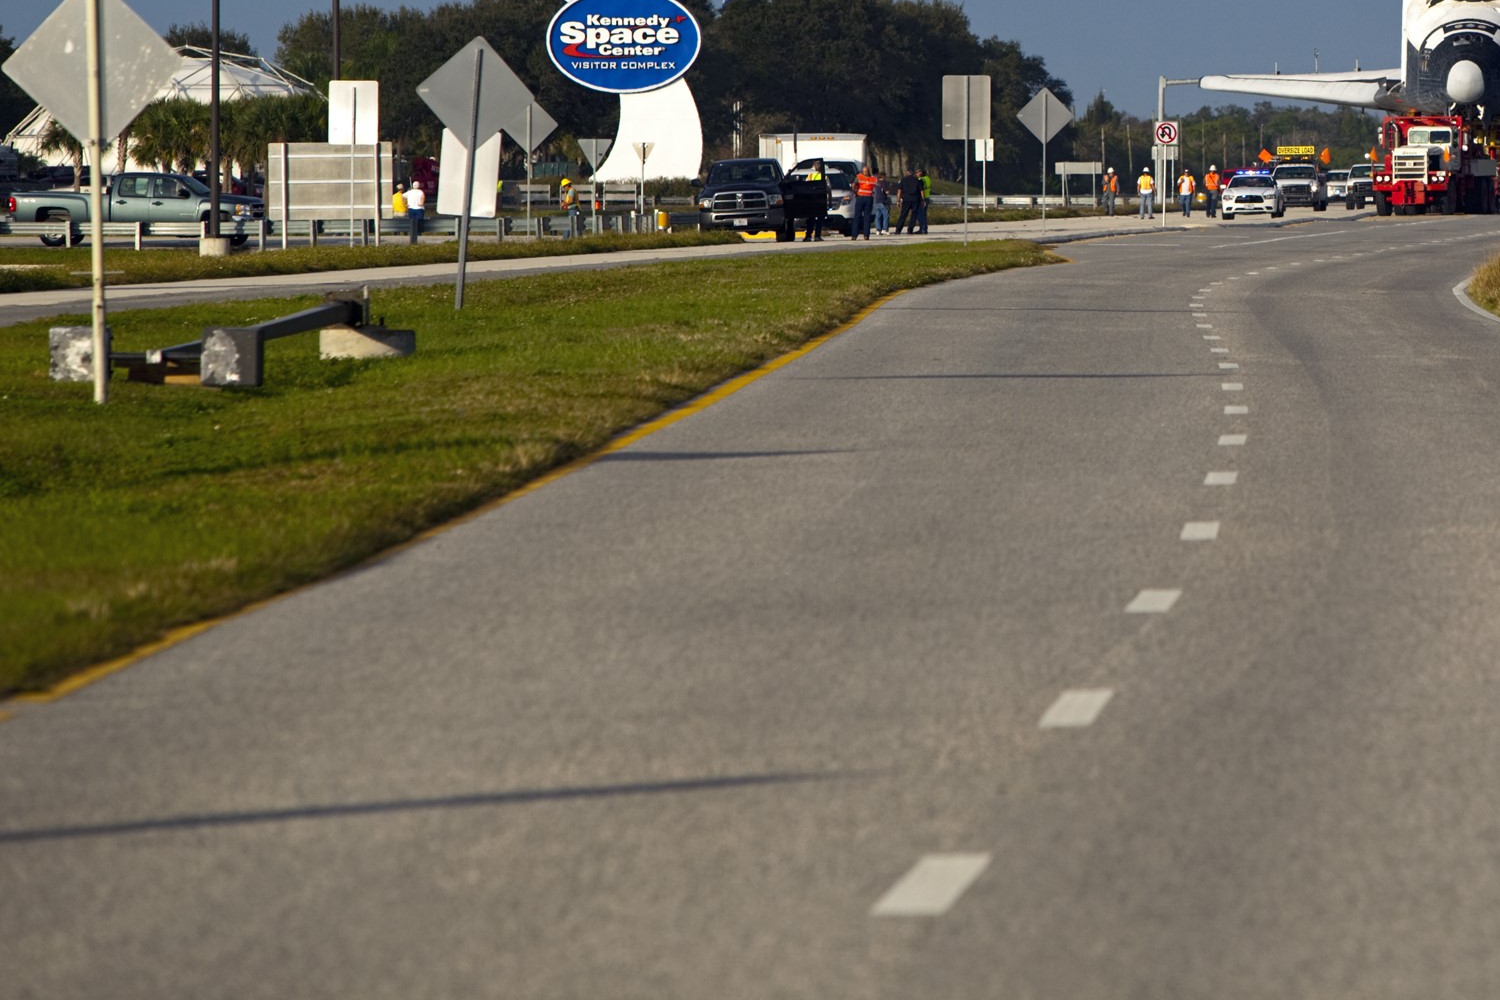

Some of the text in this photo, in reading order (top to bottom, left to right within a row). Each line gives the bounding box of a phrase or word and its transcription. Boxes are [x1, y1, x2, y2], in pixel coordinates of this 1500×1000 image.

[586, 14, 670, 28] Kennedy
[560, 21, 679, 49] Space
[598, 44, 662, 56] Center
[571, 61, 676, 70] VISITOR COMPLEX
